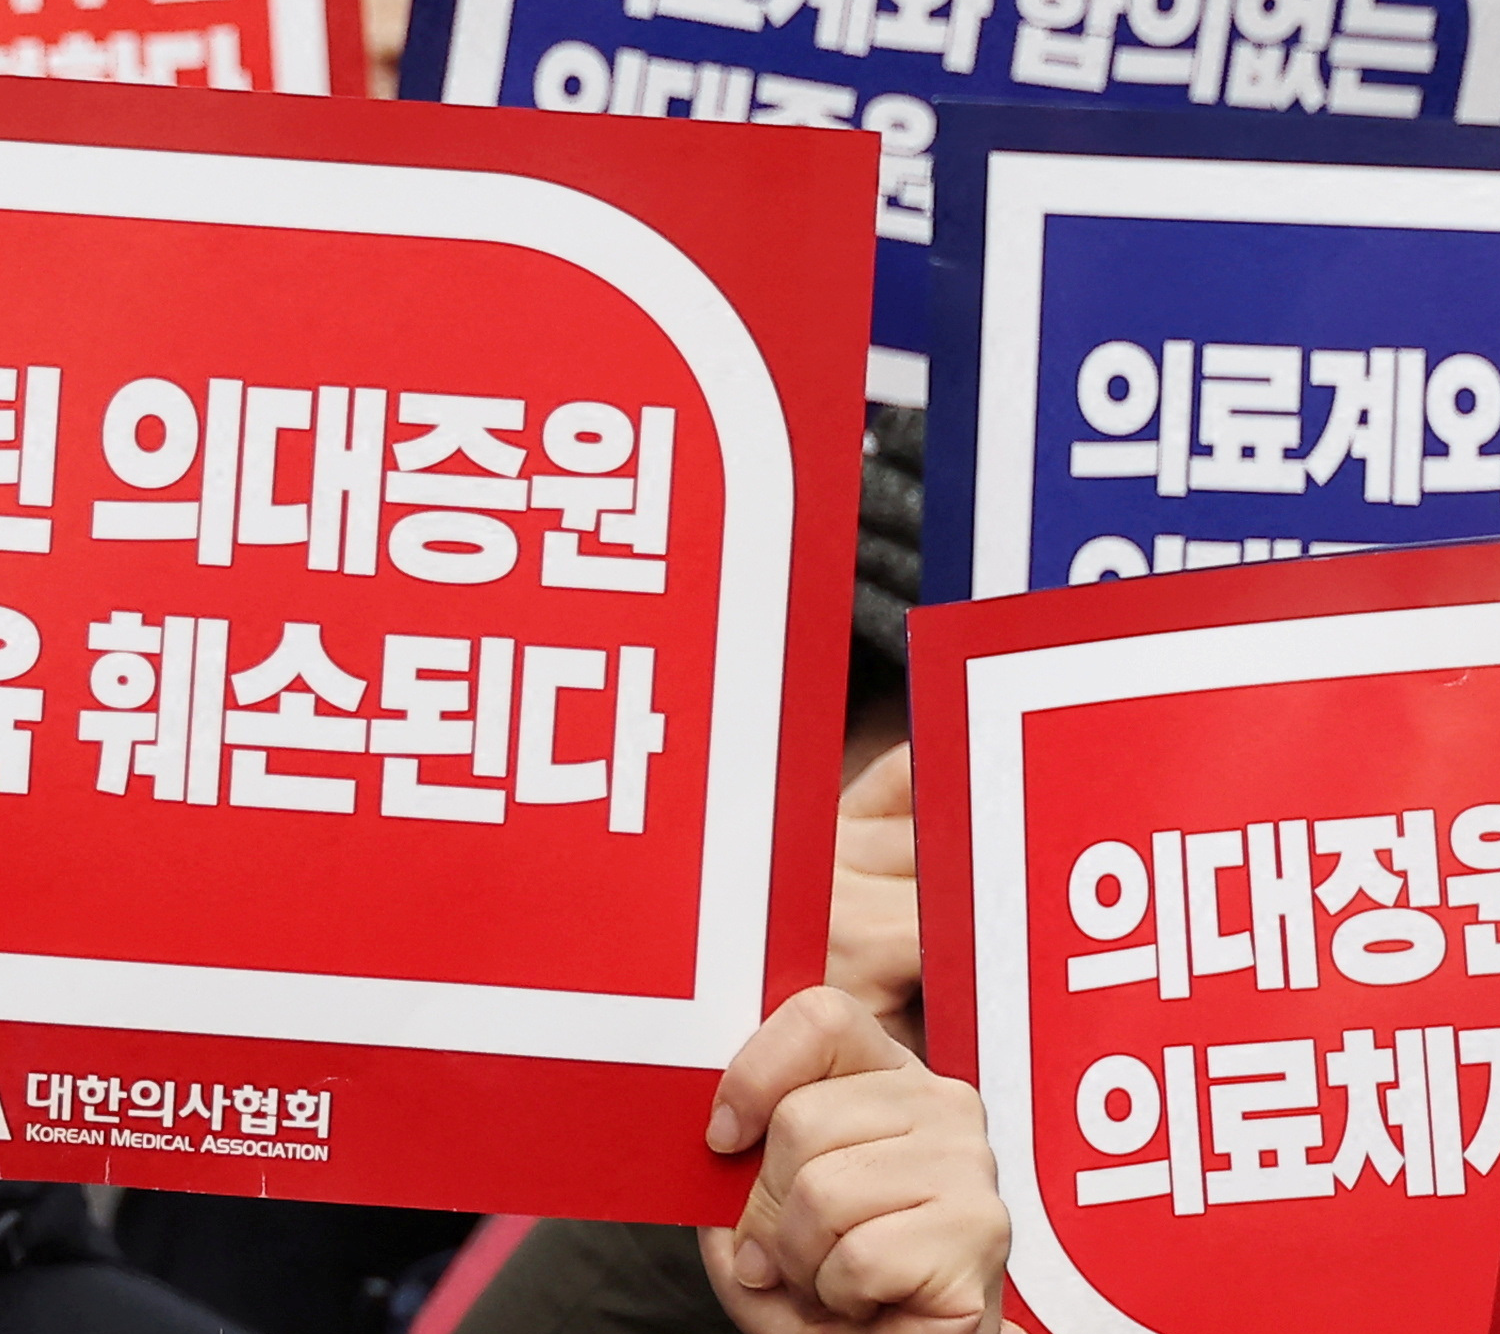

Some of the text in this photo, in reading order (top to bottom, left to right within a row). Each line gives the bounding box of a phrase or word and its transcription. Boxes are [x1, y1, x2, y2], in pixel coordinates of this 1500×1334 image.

[89, 375, 678, 595] 의대증원
[75, 610, 667, 837] 훼손된다
[25, 1121, 330, 1162] KOREAN MEDICAL ASSOCIATION
[26, 1071, 332, 1139] 대한의사협회
